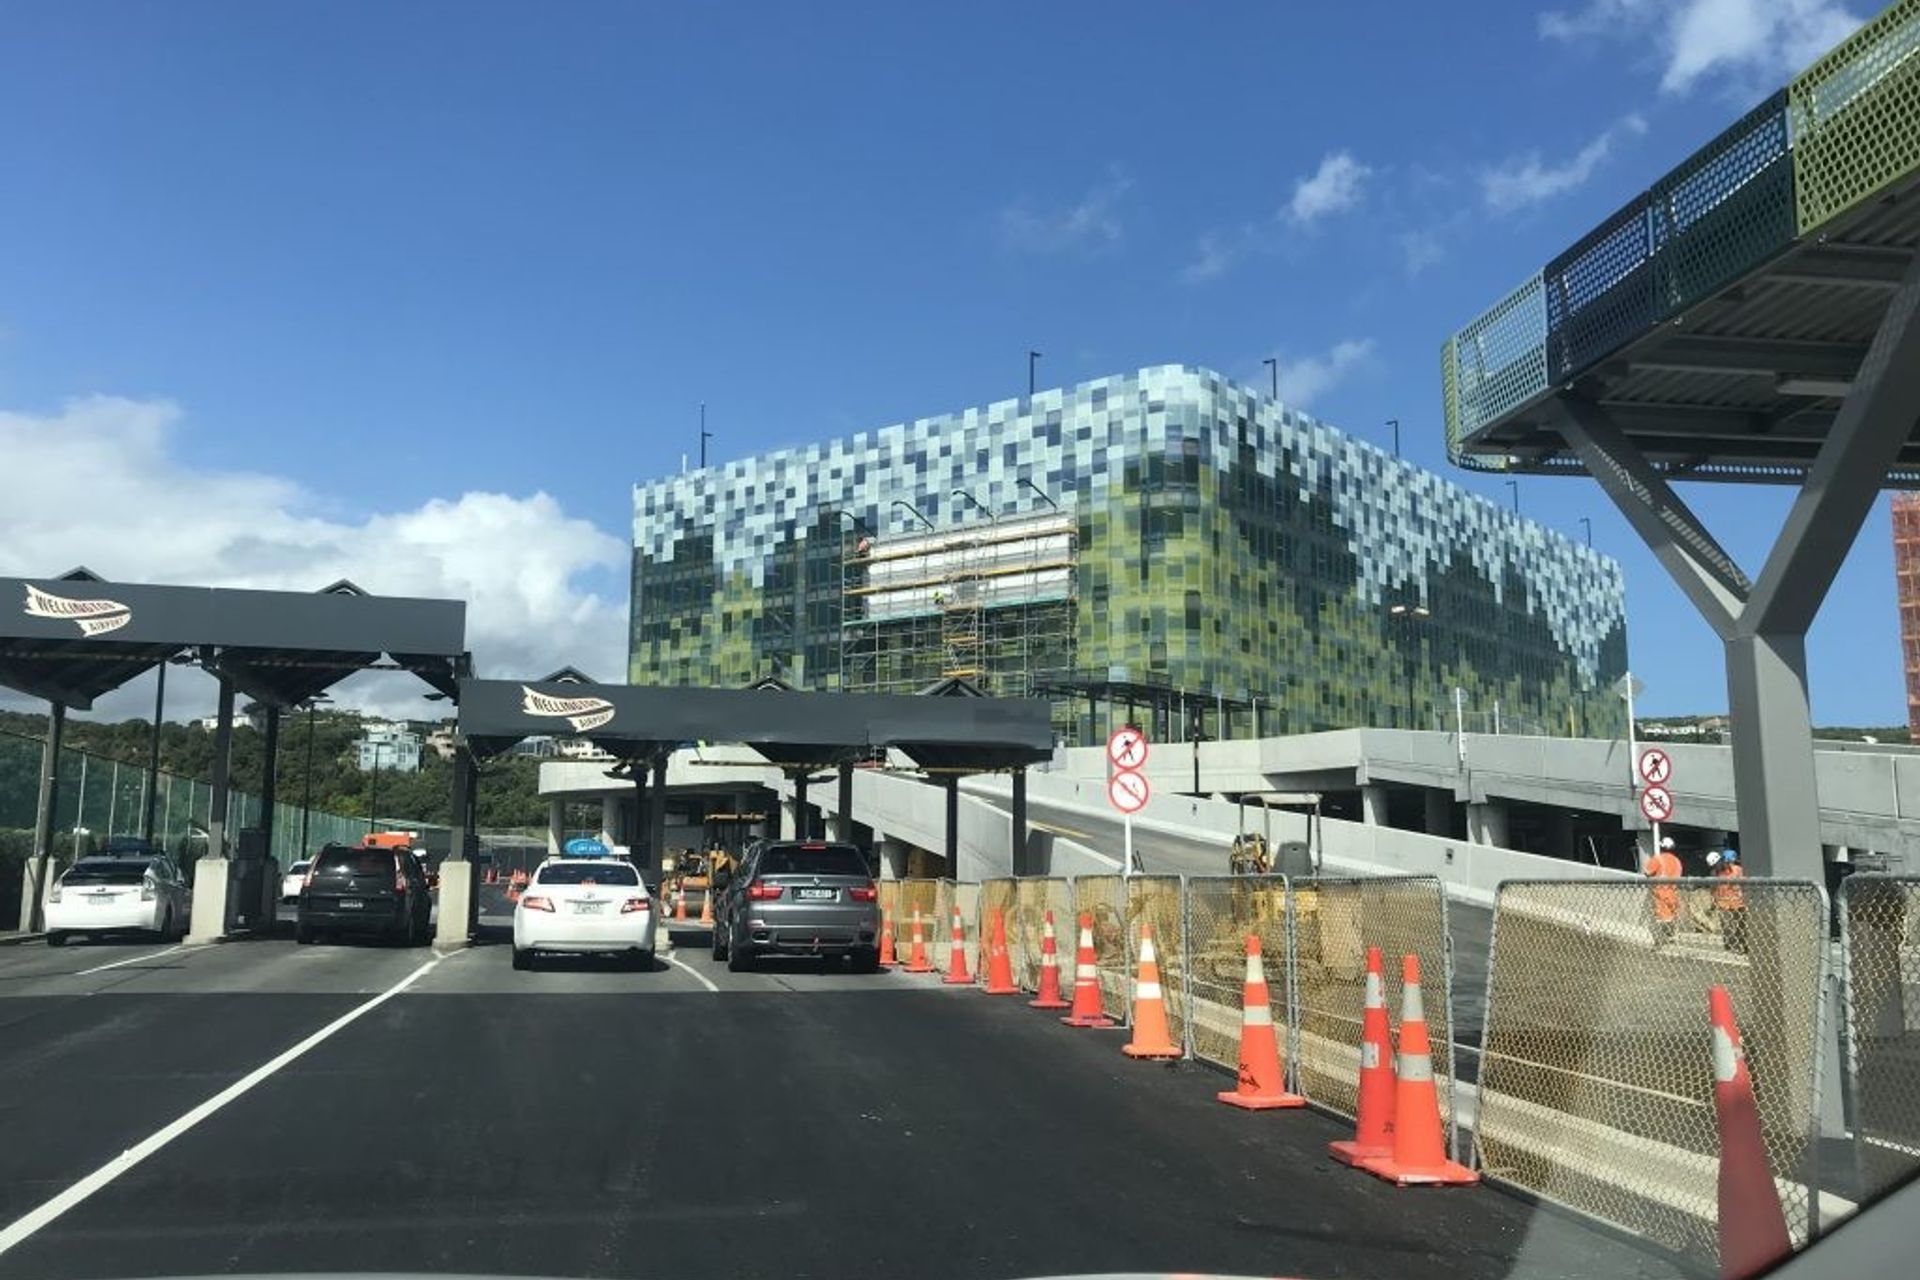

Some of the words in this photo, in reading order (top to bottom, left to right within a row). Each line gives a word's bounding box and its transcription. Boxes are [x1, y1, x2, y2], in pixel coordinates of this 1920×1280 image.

[34, 594, 116, 614] WELLINGTON
[88, 617, 124, 632] AIRPORT
[530, 694, 602, 712] WELLINGTON
[578, 712, 610, 728] AIRPORT
